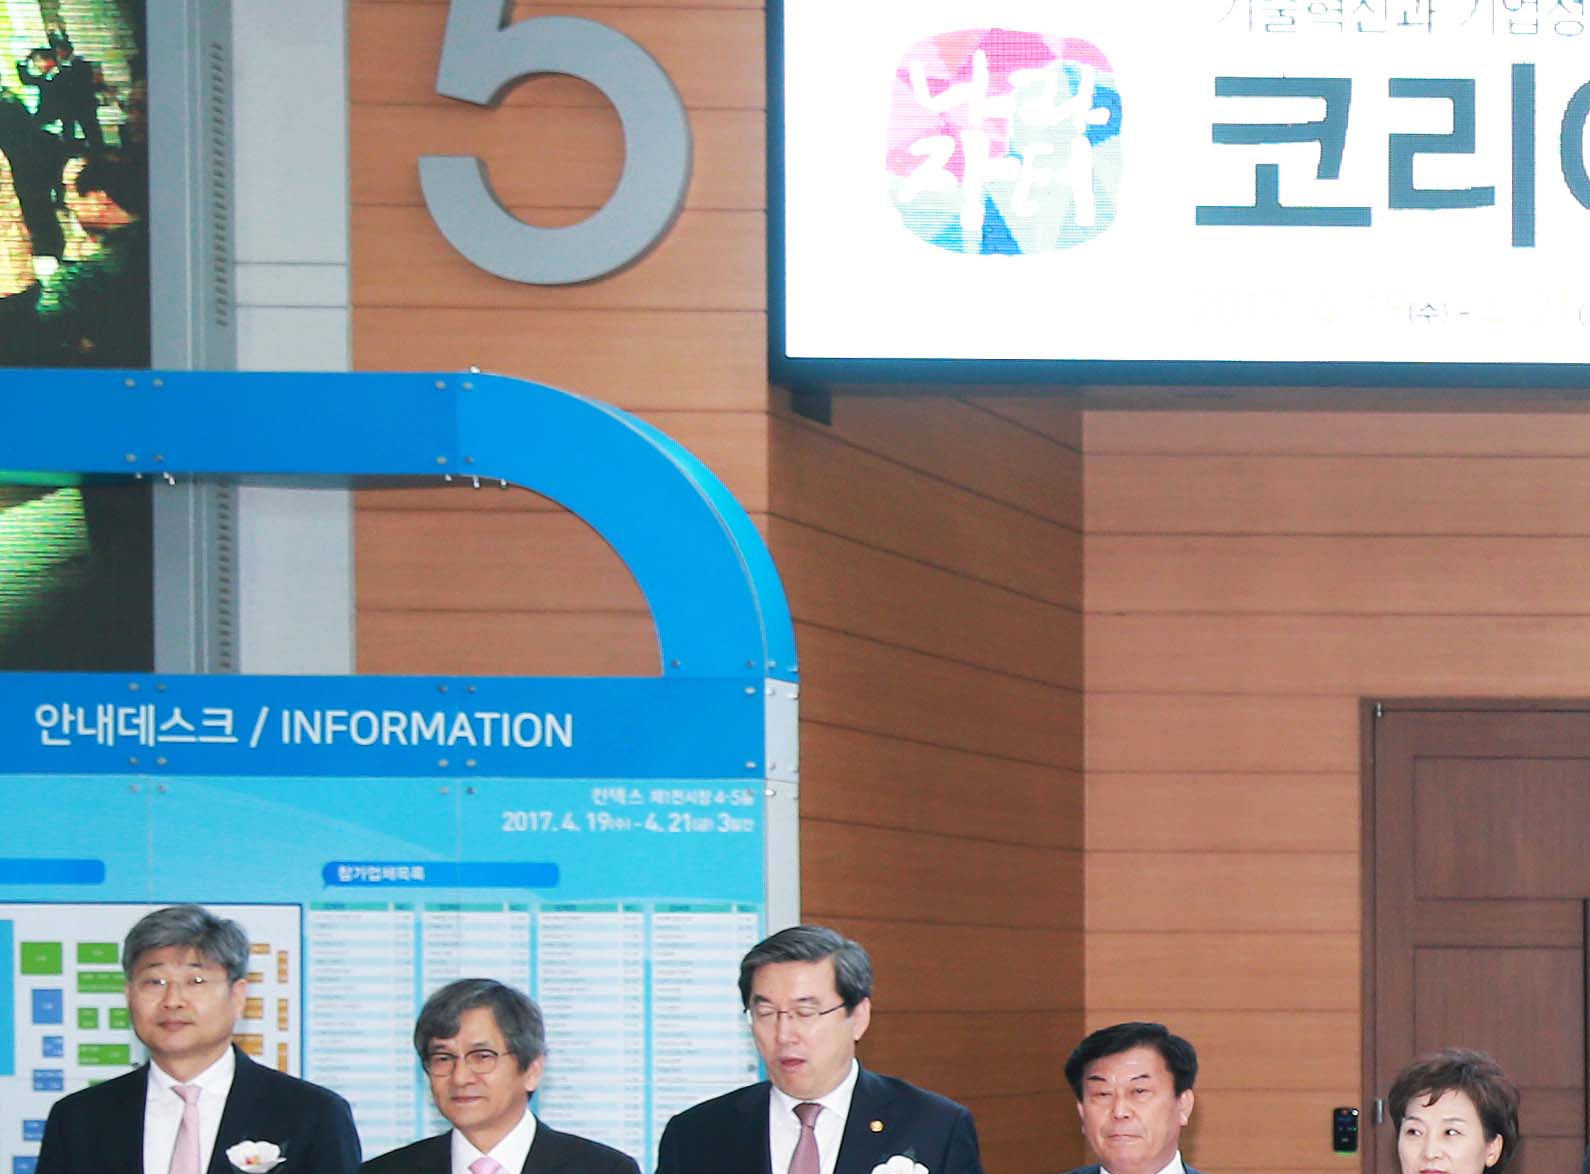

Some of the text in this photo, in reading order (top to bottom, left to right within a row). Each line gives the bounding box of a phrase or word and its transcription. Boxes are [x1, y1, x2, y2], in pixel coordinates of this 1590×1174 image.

[418, 0, 693, 287] 5
[35, 703, 574, 748] 안내데스크 / INFORMATION
[592, 787, 644, 806] 킨텍스
